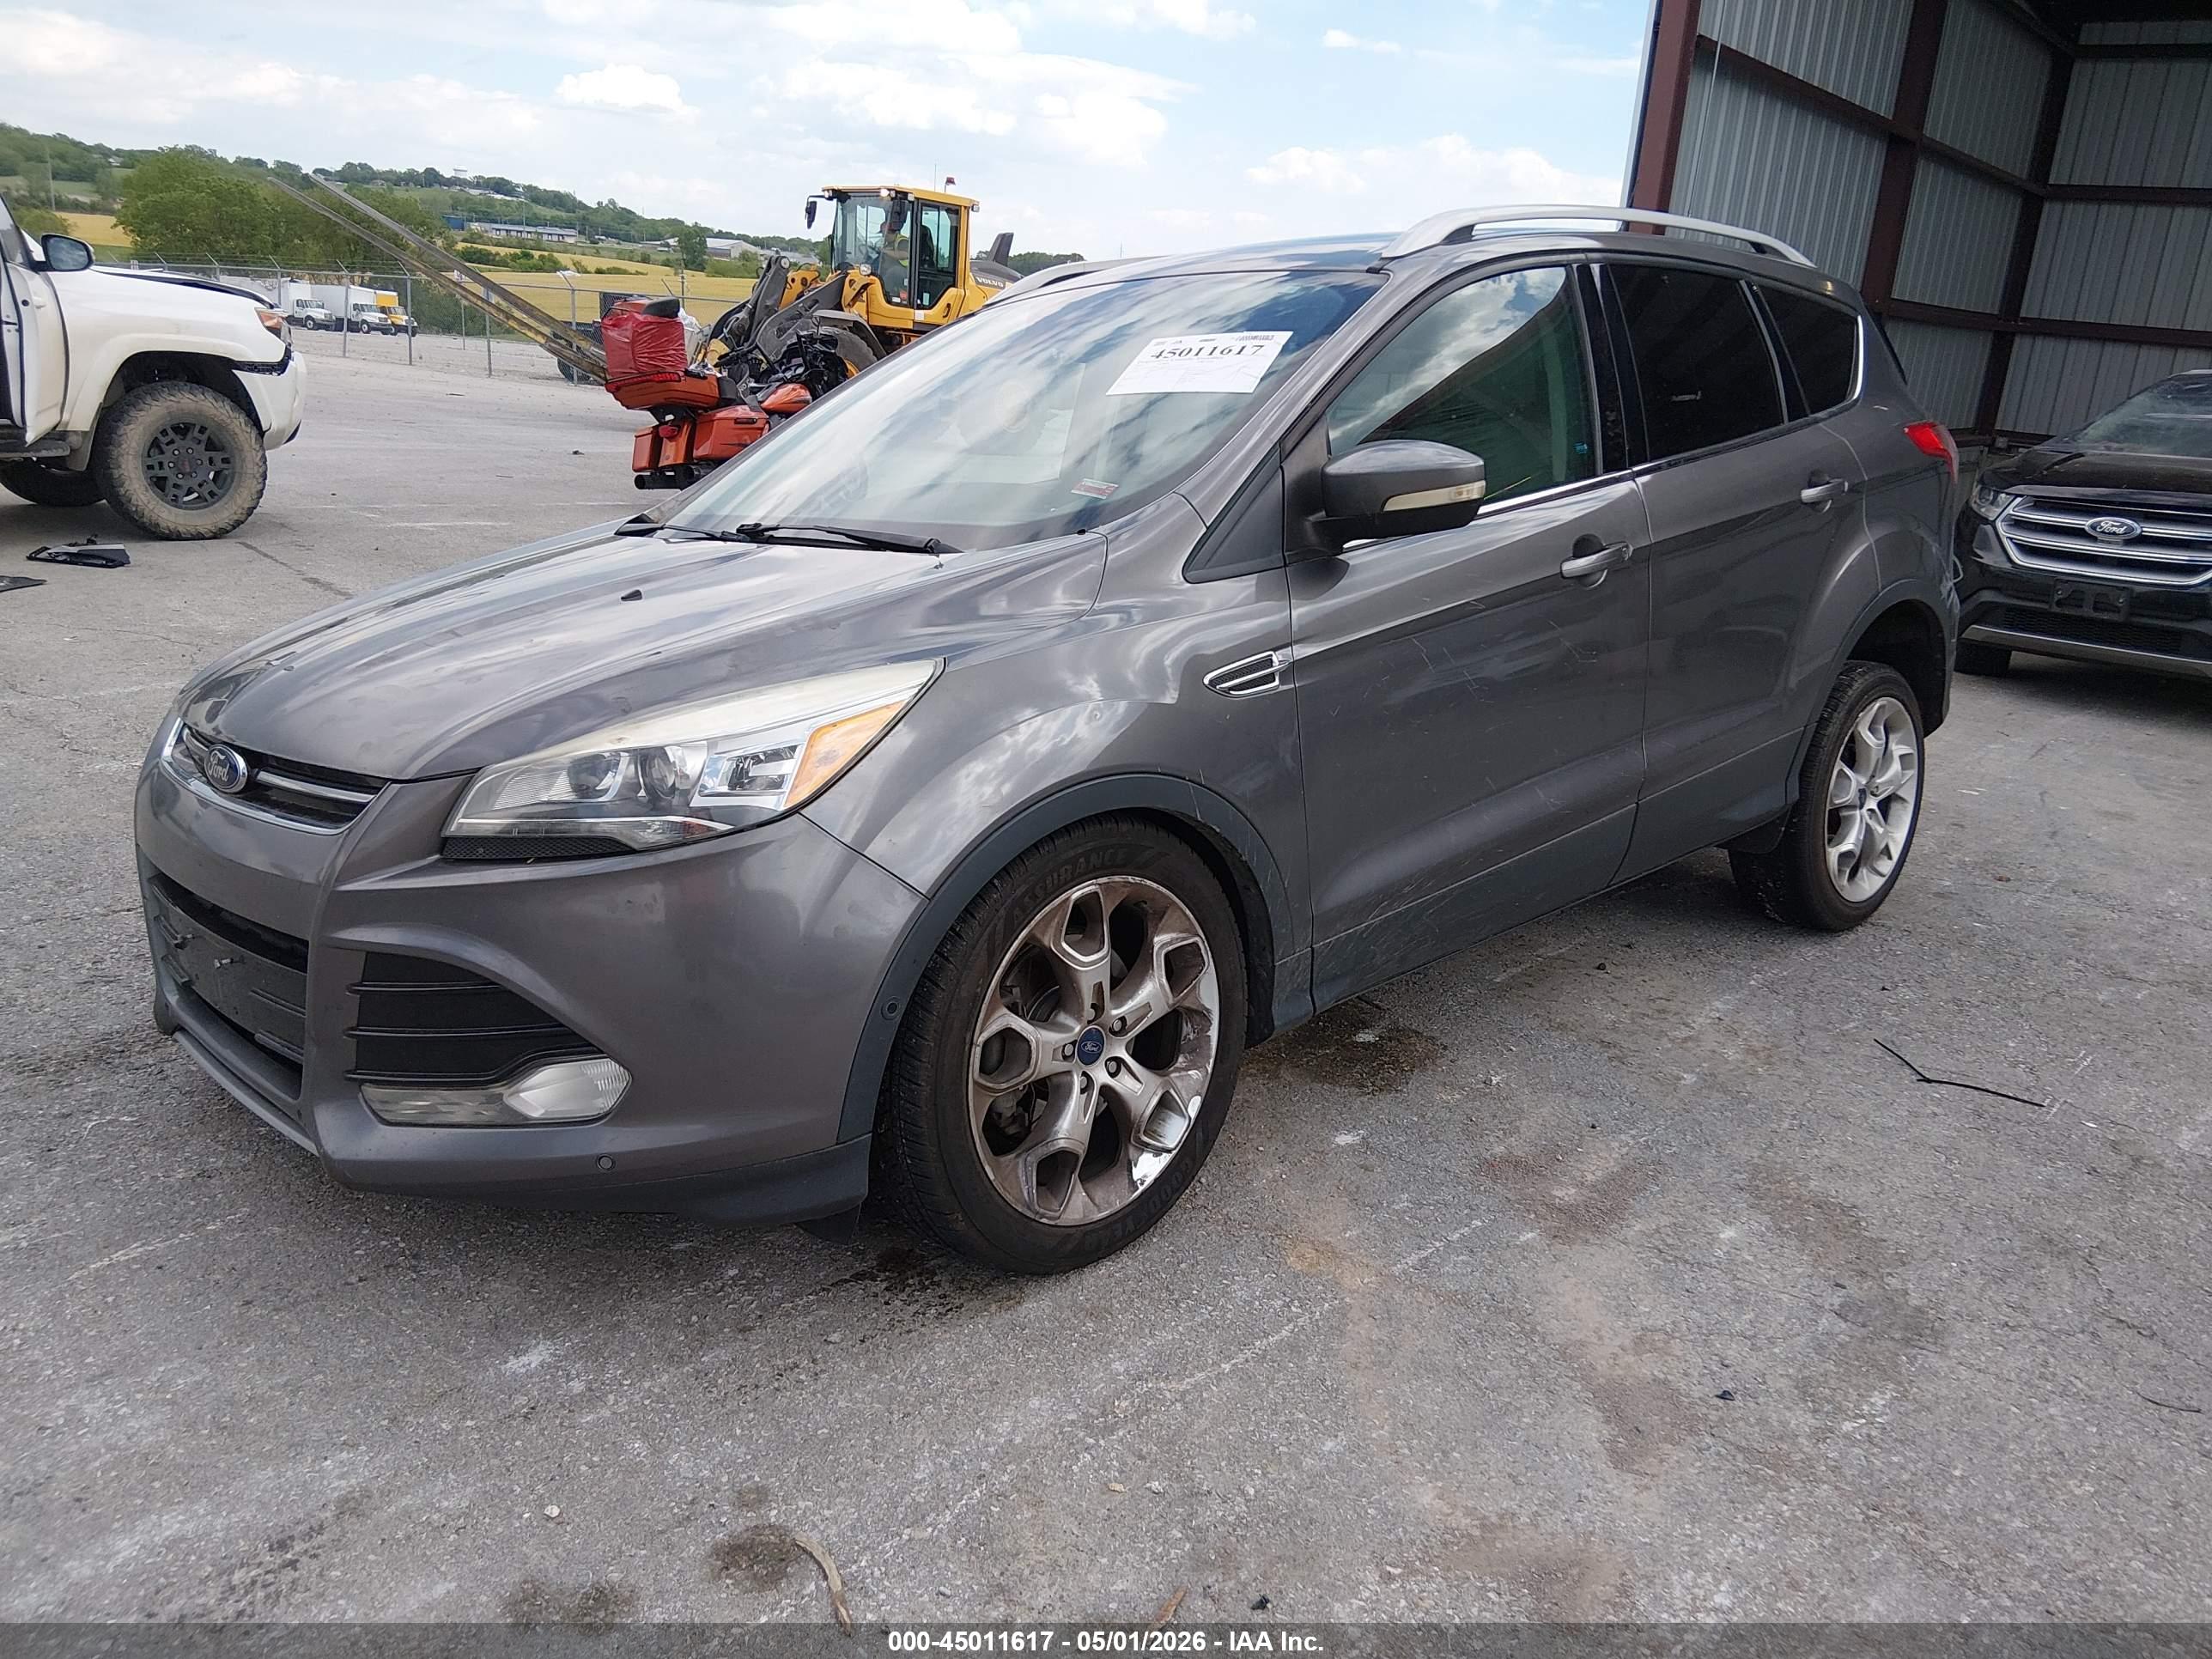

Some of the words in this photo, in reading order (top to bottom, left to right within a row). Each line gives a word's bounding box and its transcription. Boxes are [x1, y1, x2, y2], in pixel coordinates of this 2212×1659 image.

[975, 276, 1004, 287] VOLVO
[1151, 344, 1265, 359] 45011617
[2097, 521, 2127, 534] Ford
[208, 750, 230, 782] Ford
